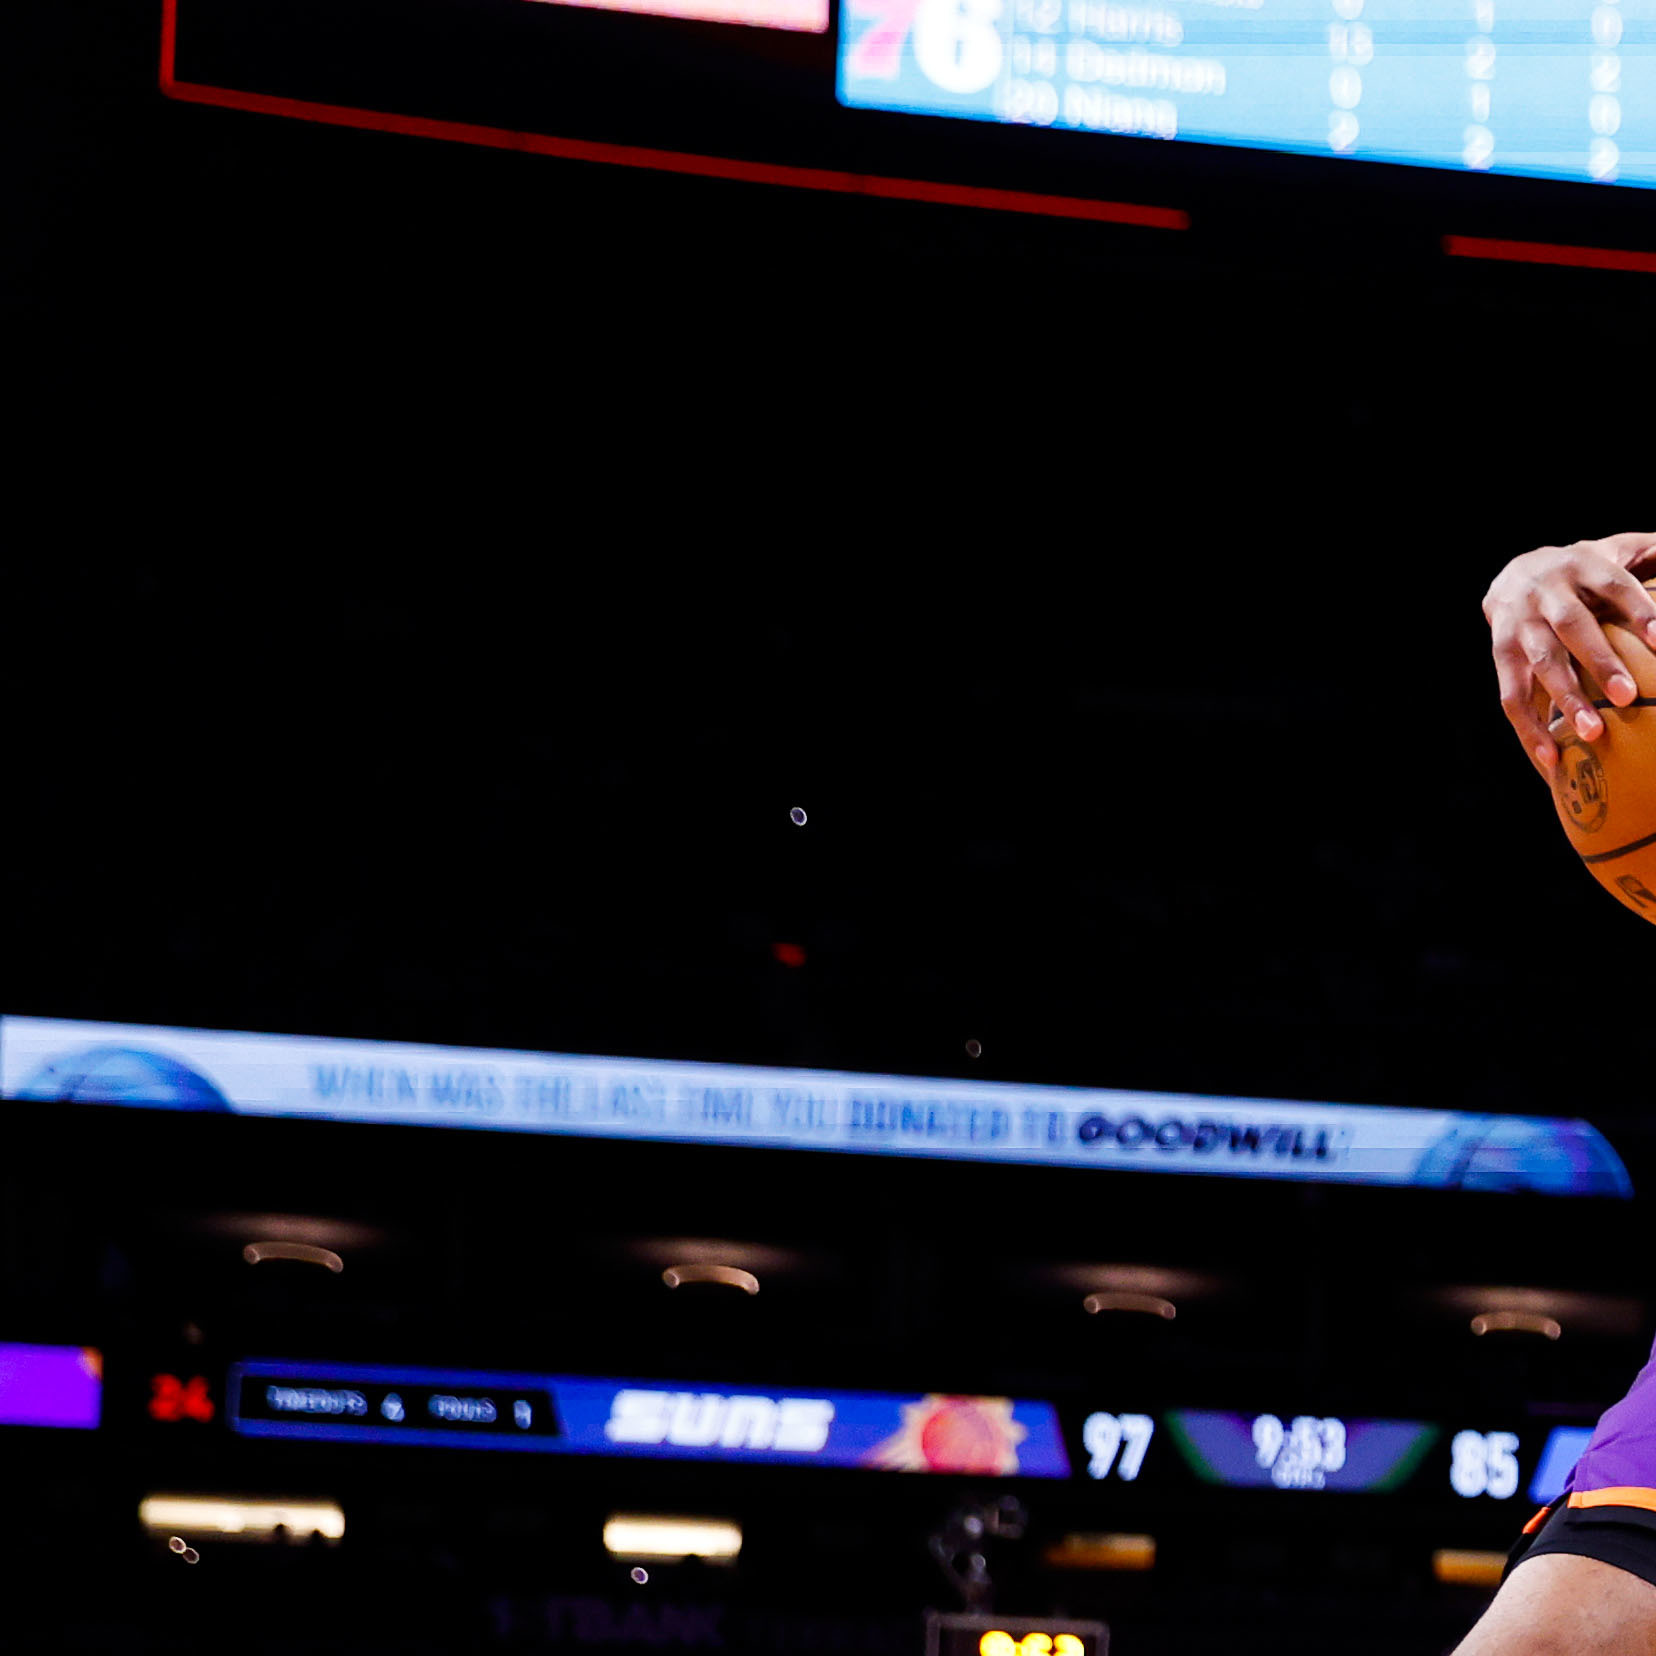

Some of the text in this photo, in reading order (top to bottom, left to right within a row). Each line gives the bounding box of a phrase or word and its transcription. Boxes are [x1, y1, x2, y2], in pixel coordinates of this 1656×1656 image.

[604, 1388, 836, 1452] SUNS
[1082, 1411, 1155, 1481] 97
[1448, 1429, 1520, 1500] 85
